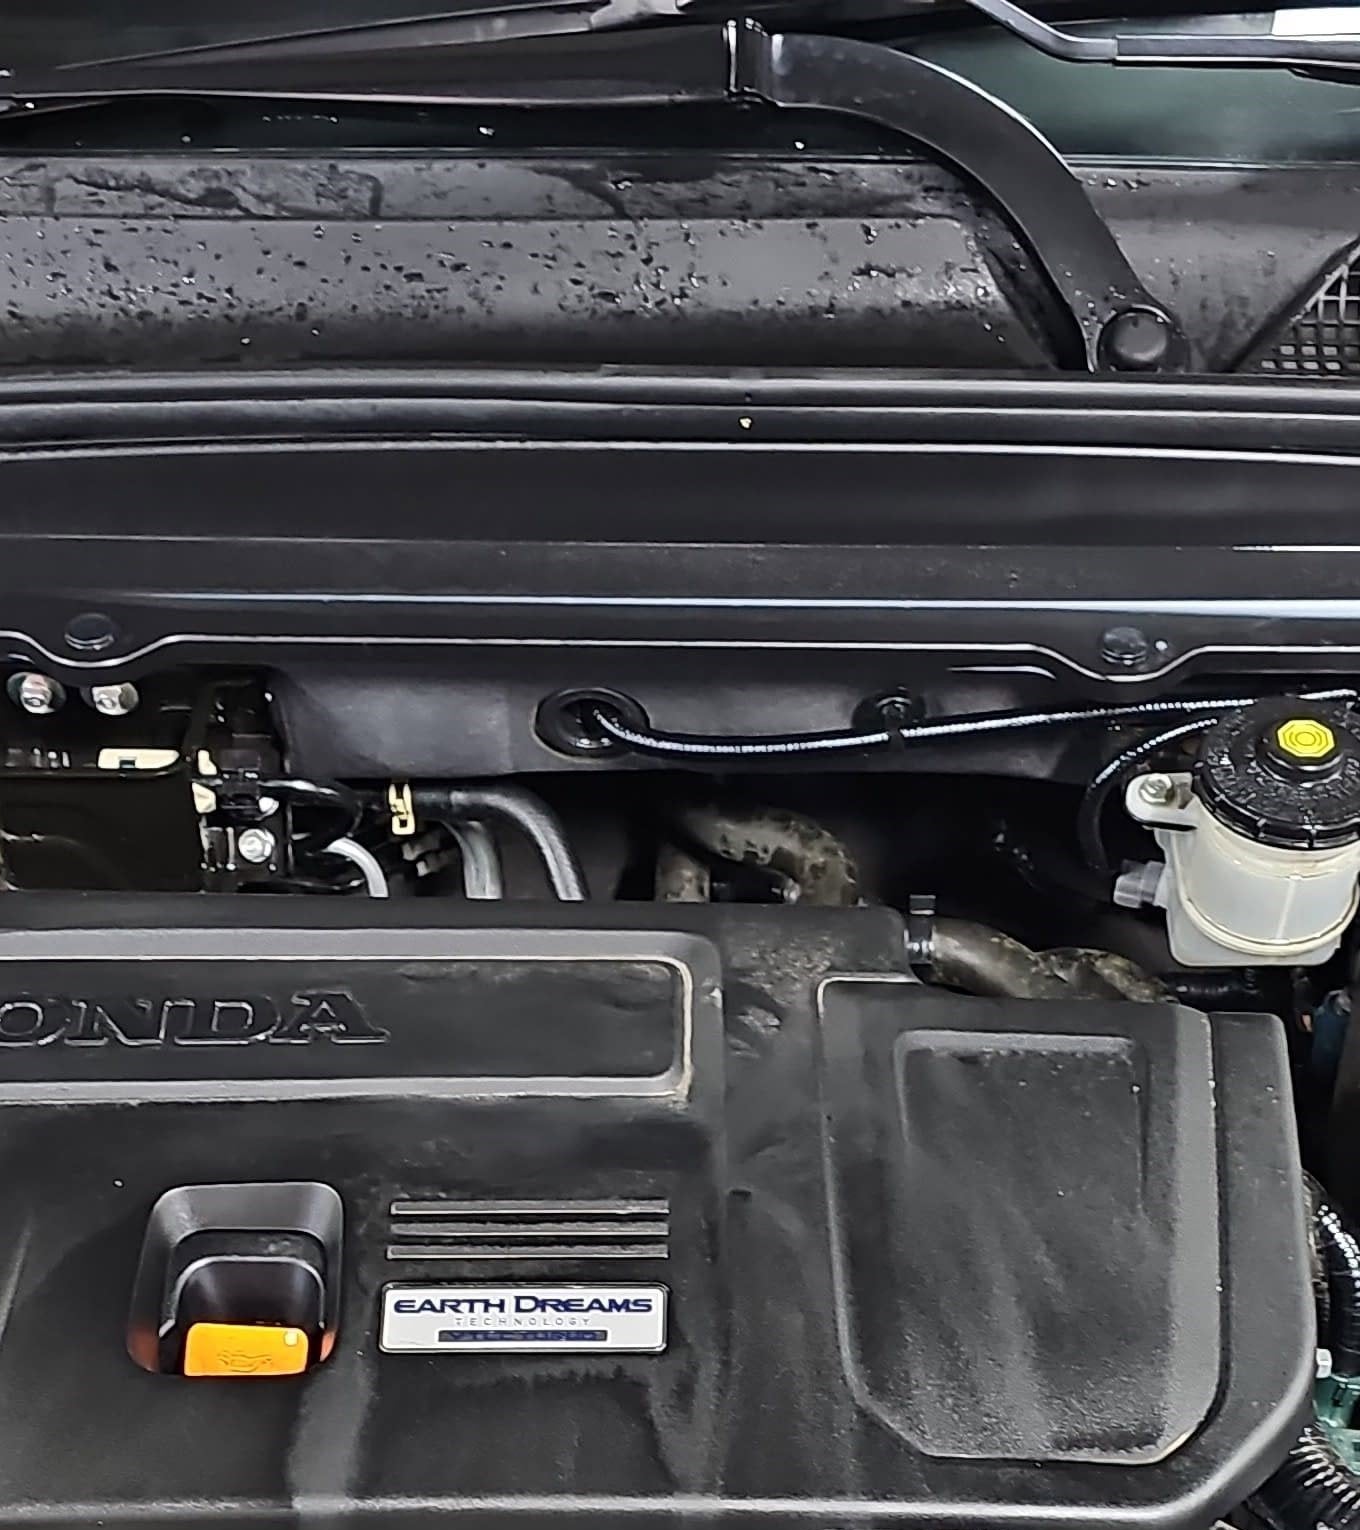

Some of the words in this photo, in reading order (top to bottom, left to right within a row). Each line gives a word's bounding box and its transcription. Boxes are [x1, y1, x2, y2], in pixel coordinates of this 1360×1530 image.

[394, 1298, 505, 1314] EARTH
[514, 1295, 653, 1313] DREAMS
[456, 1317, 590, 1326] TECHNOLOGY
